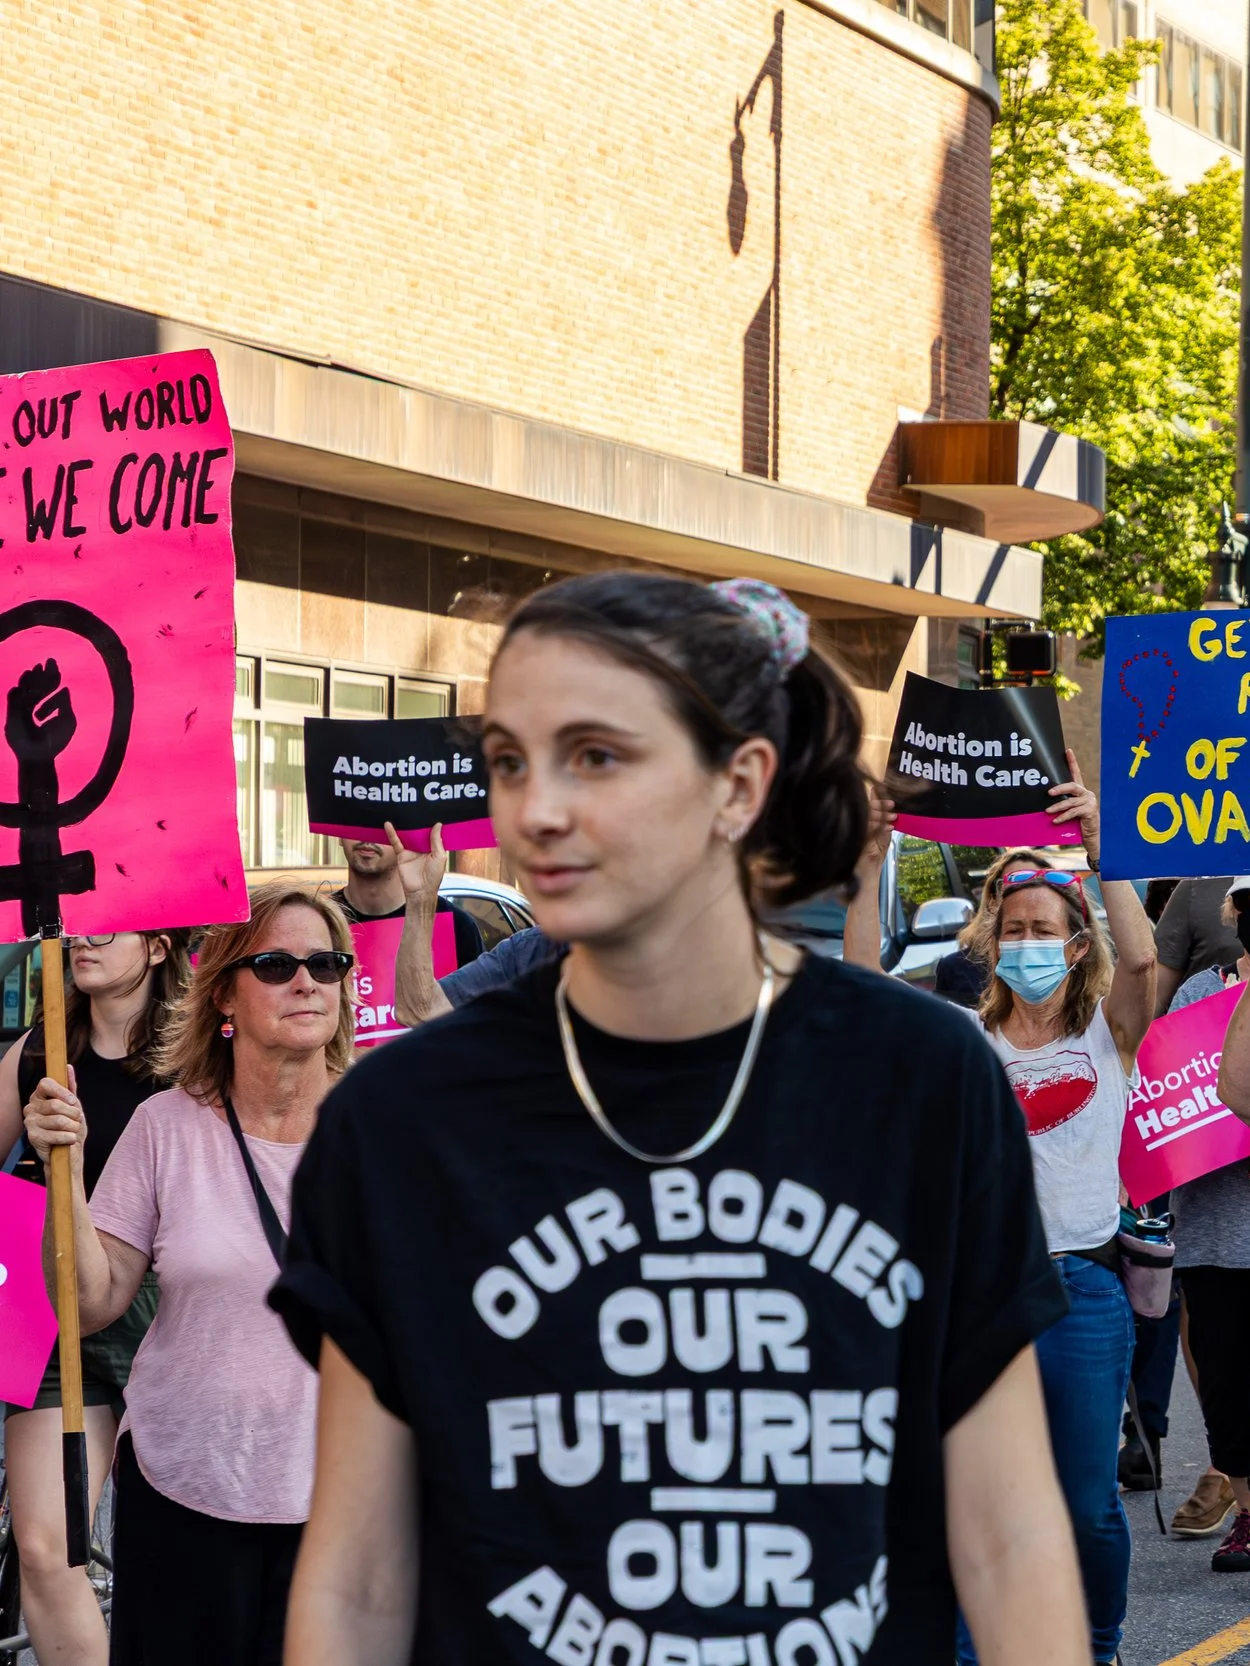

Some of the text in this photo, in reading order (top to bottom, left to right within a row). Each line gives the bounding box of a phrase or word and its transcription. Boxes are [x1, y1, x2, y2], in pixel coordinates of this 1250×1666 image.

[12, 373, 212, 447] OUT WORLD
[22, 459, 93, 543] WE
[109, 447, 228, 534] COME
[332, 752, 473, 777] Abortion is
[899, 750, 1049, 787] Health Care.
[905, 721, 1032, 757] Abortion is
[334, 779, 486, 802] Health Care.
[1128, 1051, 1222, 1112] Abortio
[1134, 1083, 1222, 1140] Healt
[1028, 1123, 1053, 1136] PUBLIC
[1055, 1116, 1065, 1126] OF
[472, 1167, 924, 1340] OUR BODIES
[598, 1286, 810, 1377] OUR
[486, 1387, 898, 1490] FUTURES
[607, 1518, 814, 1611] OUR
